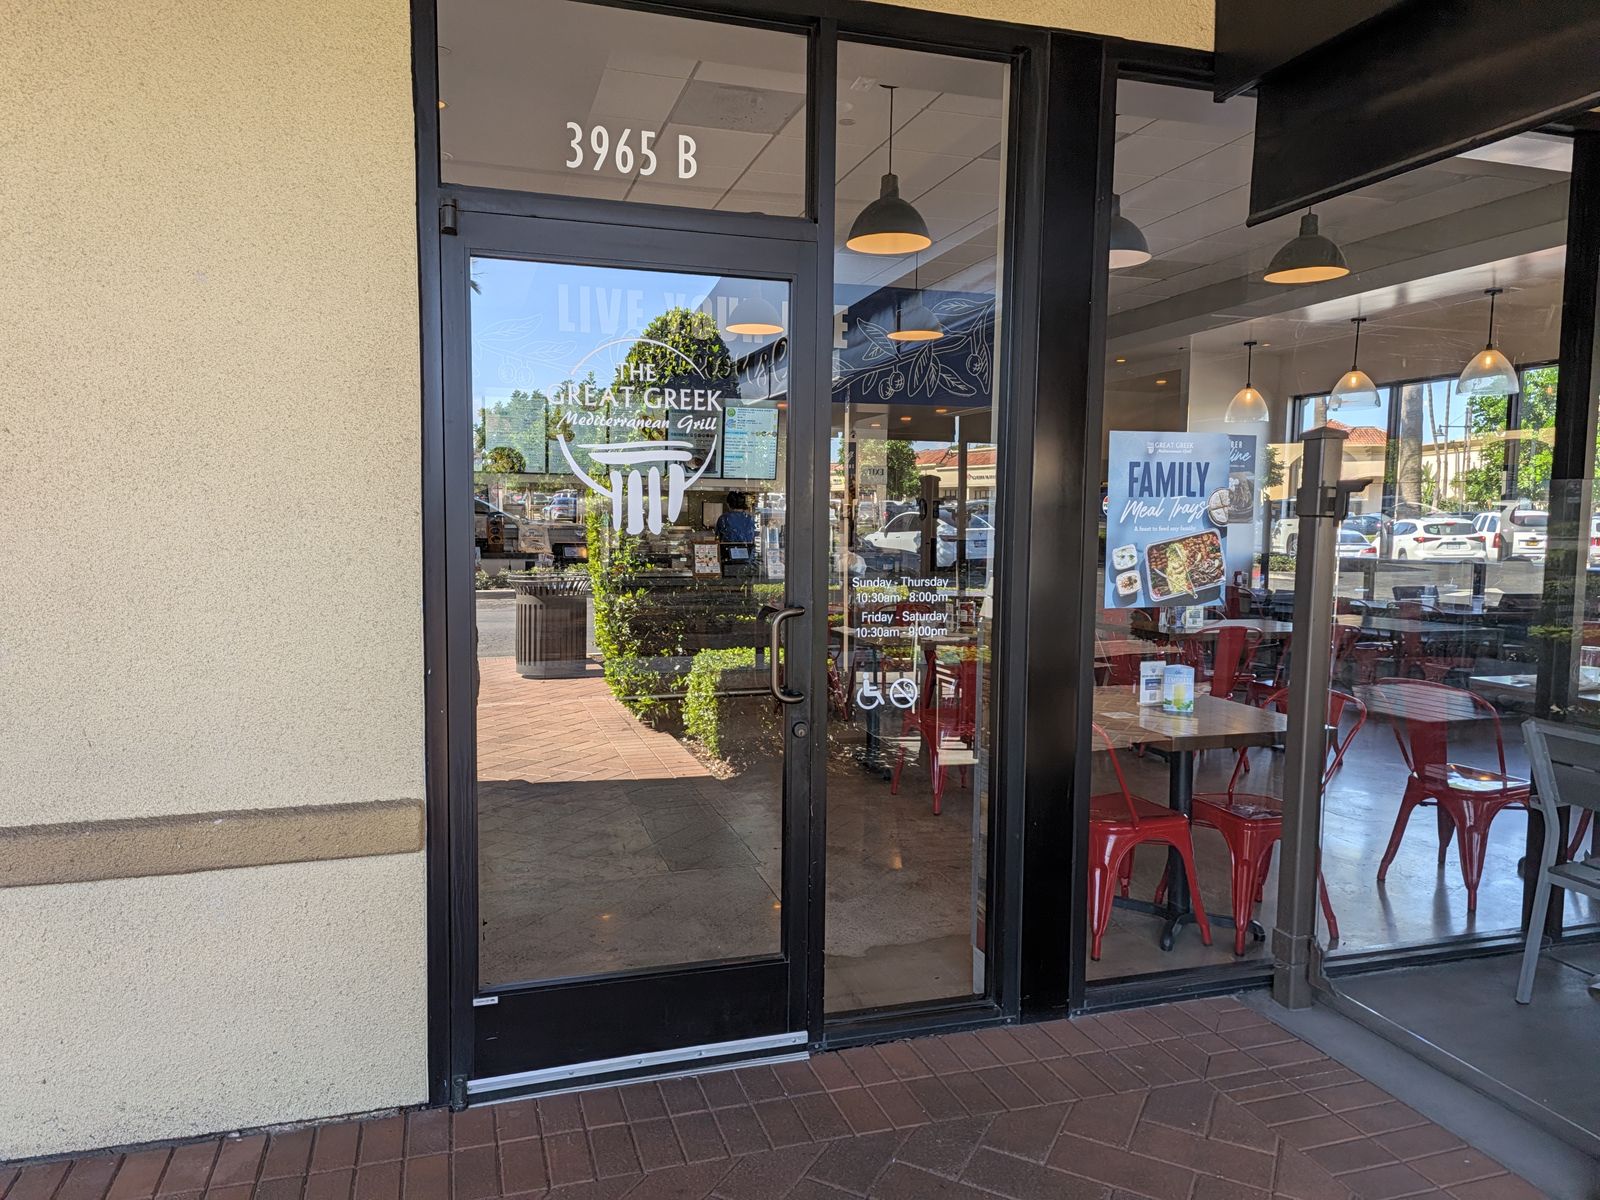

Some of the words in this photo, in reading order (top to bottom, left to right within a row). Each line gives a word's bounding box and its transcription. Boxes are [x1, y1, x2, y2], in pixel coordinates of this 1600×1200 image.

[566, 121, 657, 176] 3965
[678, 134, 697, 179] B
[557, 283, 644, 335] LIVE
[616, 362, 657, 382] THE
[546, 383, 635, 408] GREAT
[644, 387, 723, 412] GREEK
[556, 410, 670, 429] Mediterranean
[677, 415, 717, 433] Grill
[1128, 461, 1210, 498] FAMILY
[1120, 498, 1165, 523] Meal
[1168, 495, 1210, 523] Trays
[852, 577, 892, 588] Sunday
[900, 576, 949, 588] Thursday
[856, 592, 900, 603] 10:30am
[908, 591, 948, 604] 8:00pm
[861, 611, 893, 624] Friday
[902, 610, 948, 623] Saturday
[855, 627, 900, 638] 10:30am
[908, 626, 948, 638] 9:00pm
